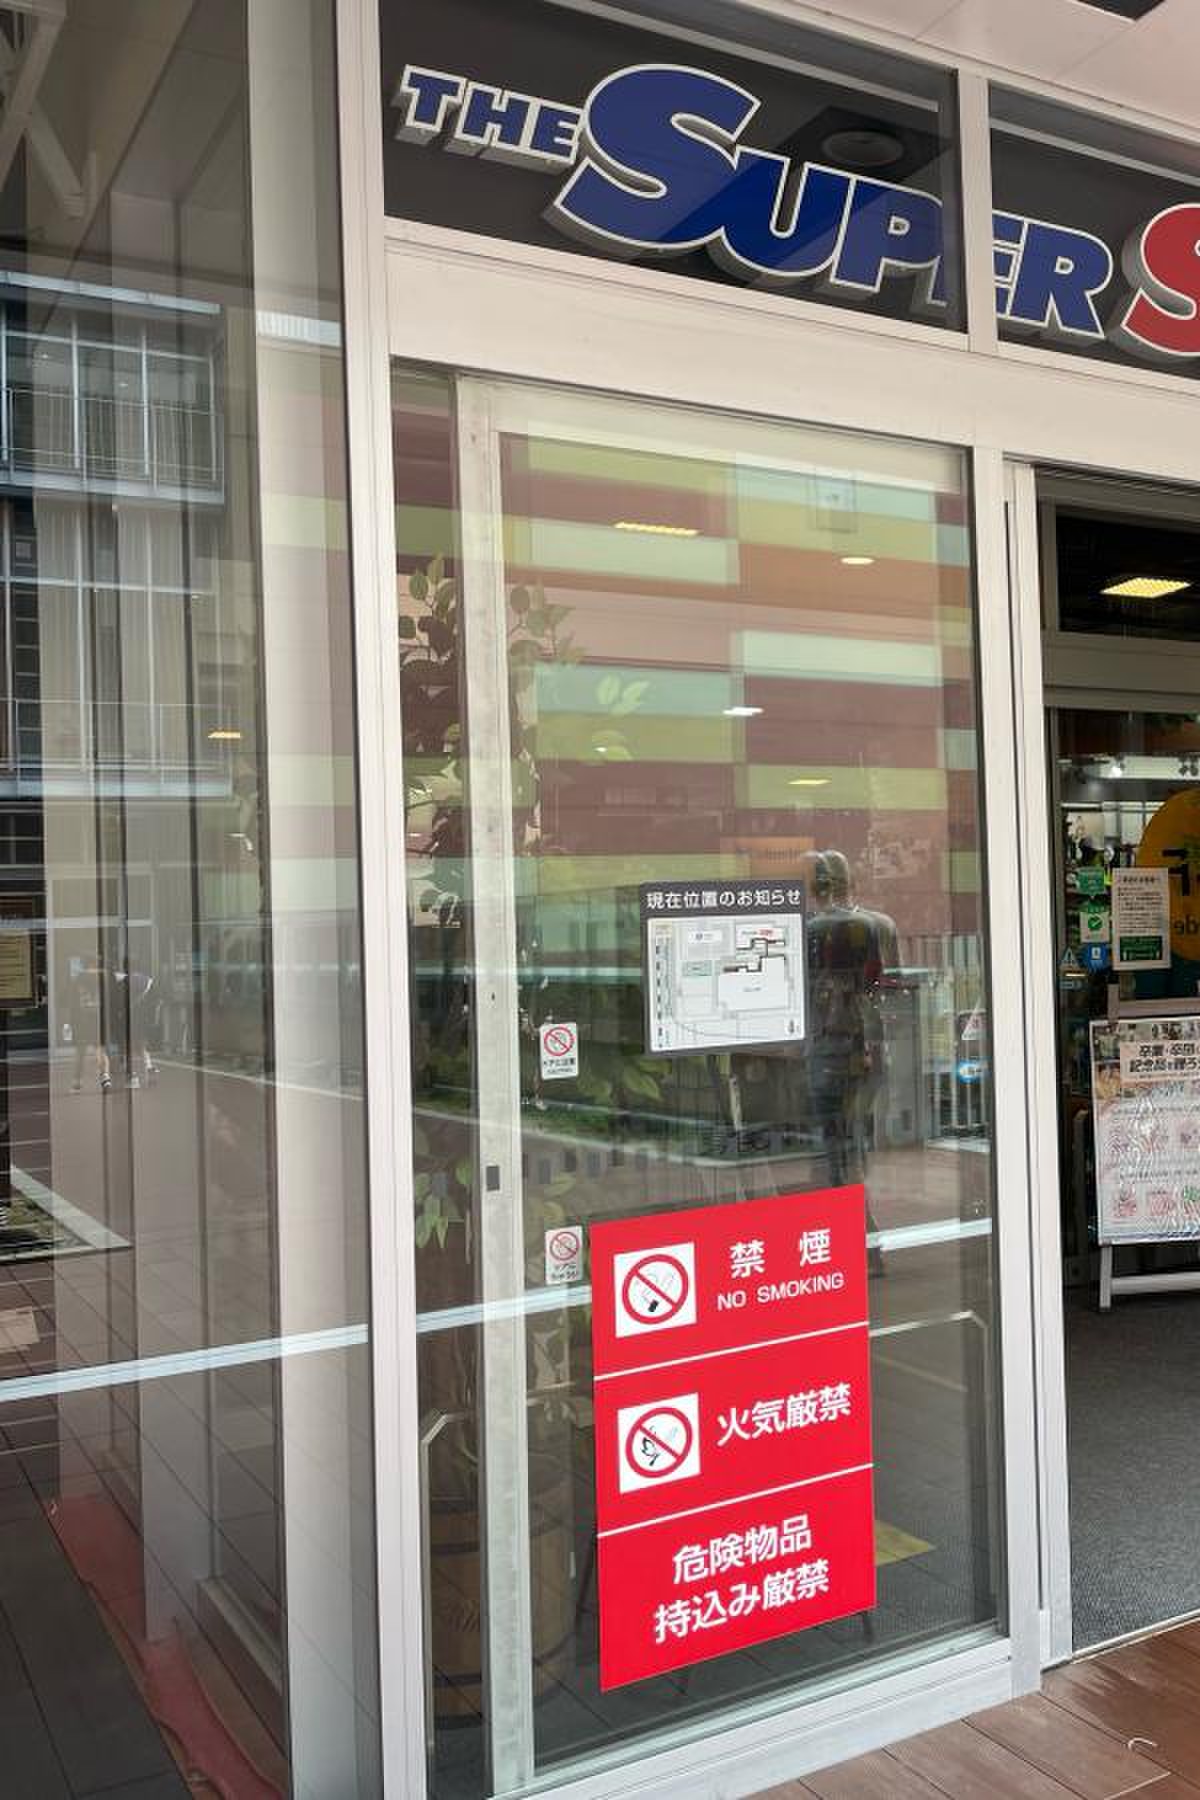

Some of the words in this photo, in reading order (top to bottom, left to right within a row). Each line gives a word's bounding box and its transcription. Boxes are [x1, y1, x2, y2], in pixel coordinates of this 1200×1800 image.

[400, 64, 586, 165] THE
[646, 888, 802, 910] 現在位置のお知らせ
[717, 1290, 747, 1312] NO
[757, 1272, 845, 1304] SMOKING
[716, 1383, 851, 1448] 火気厳禁
[672, 1513, 814, 1585] 危険物品
[654, 1559, 830, 1645] 持込み厳禁
